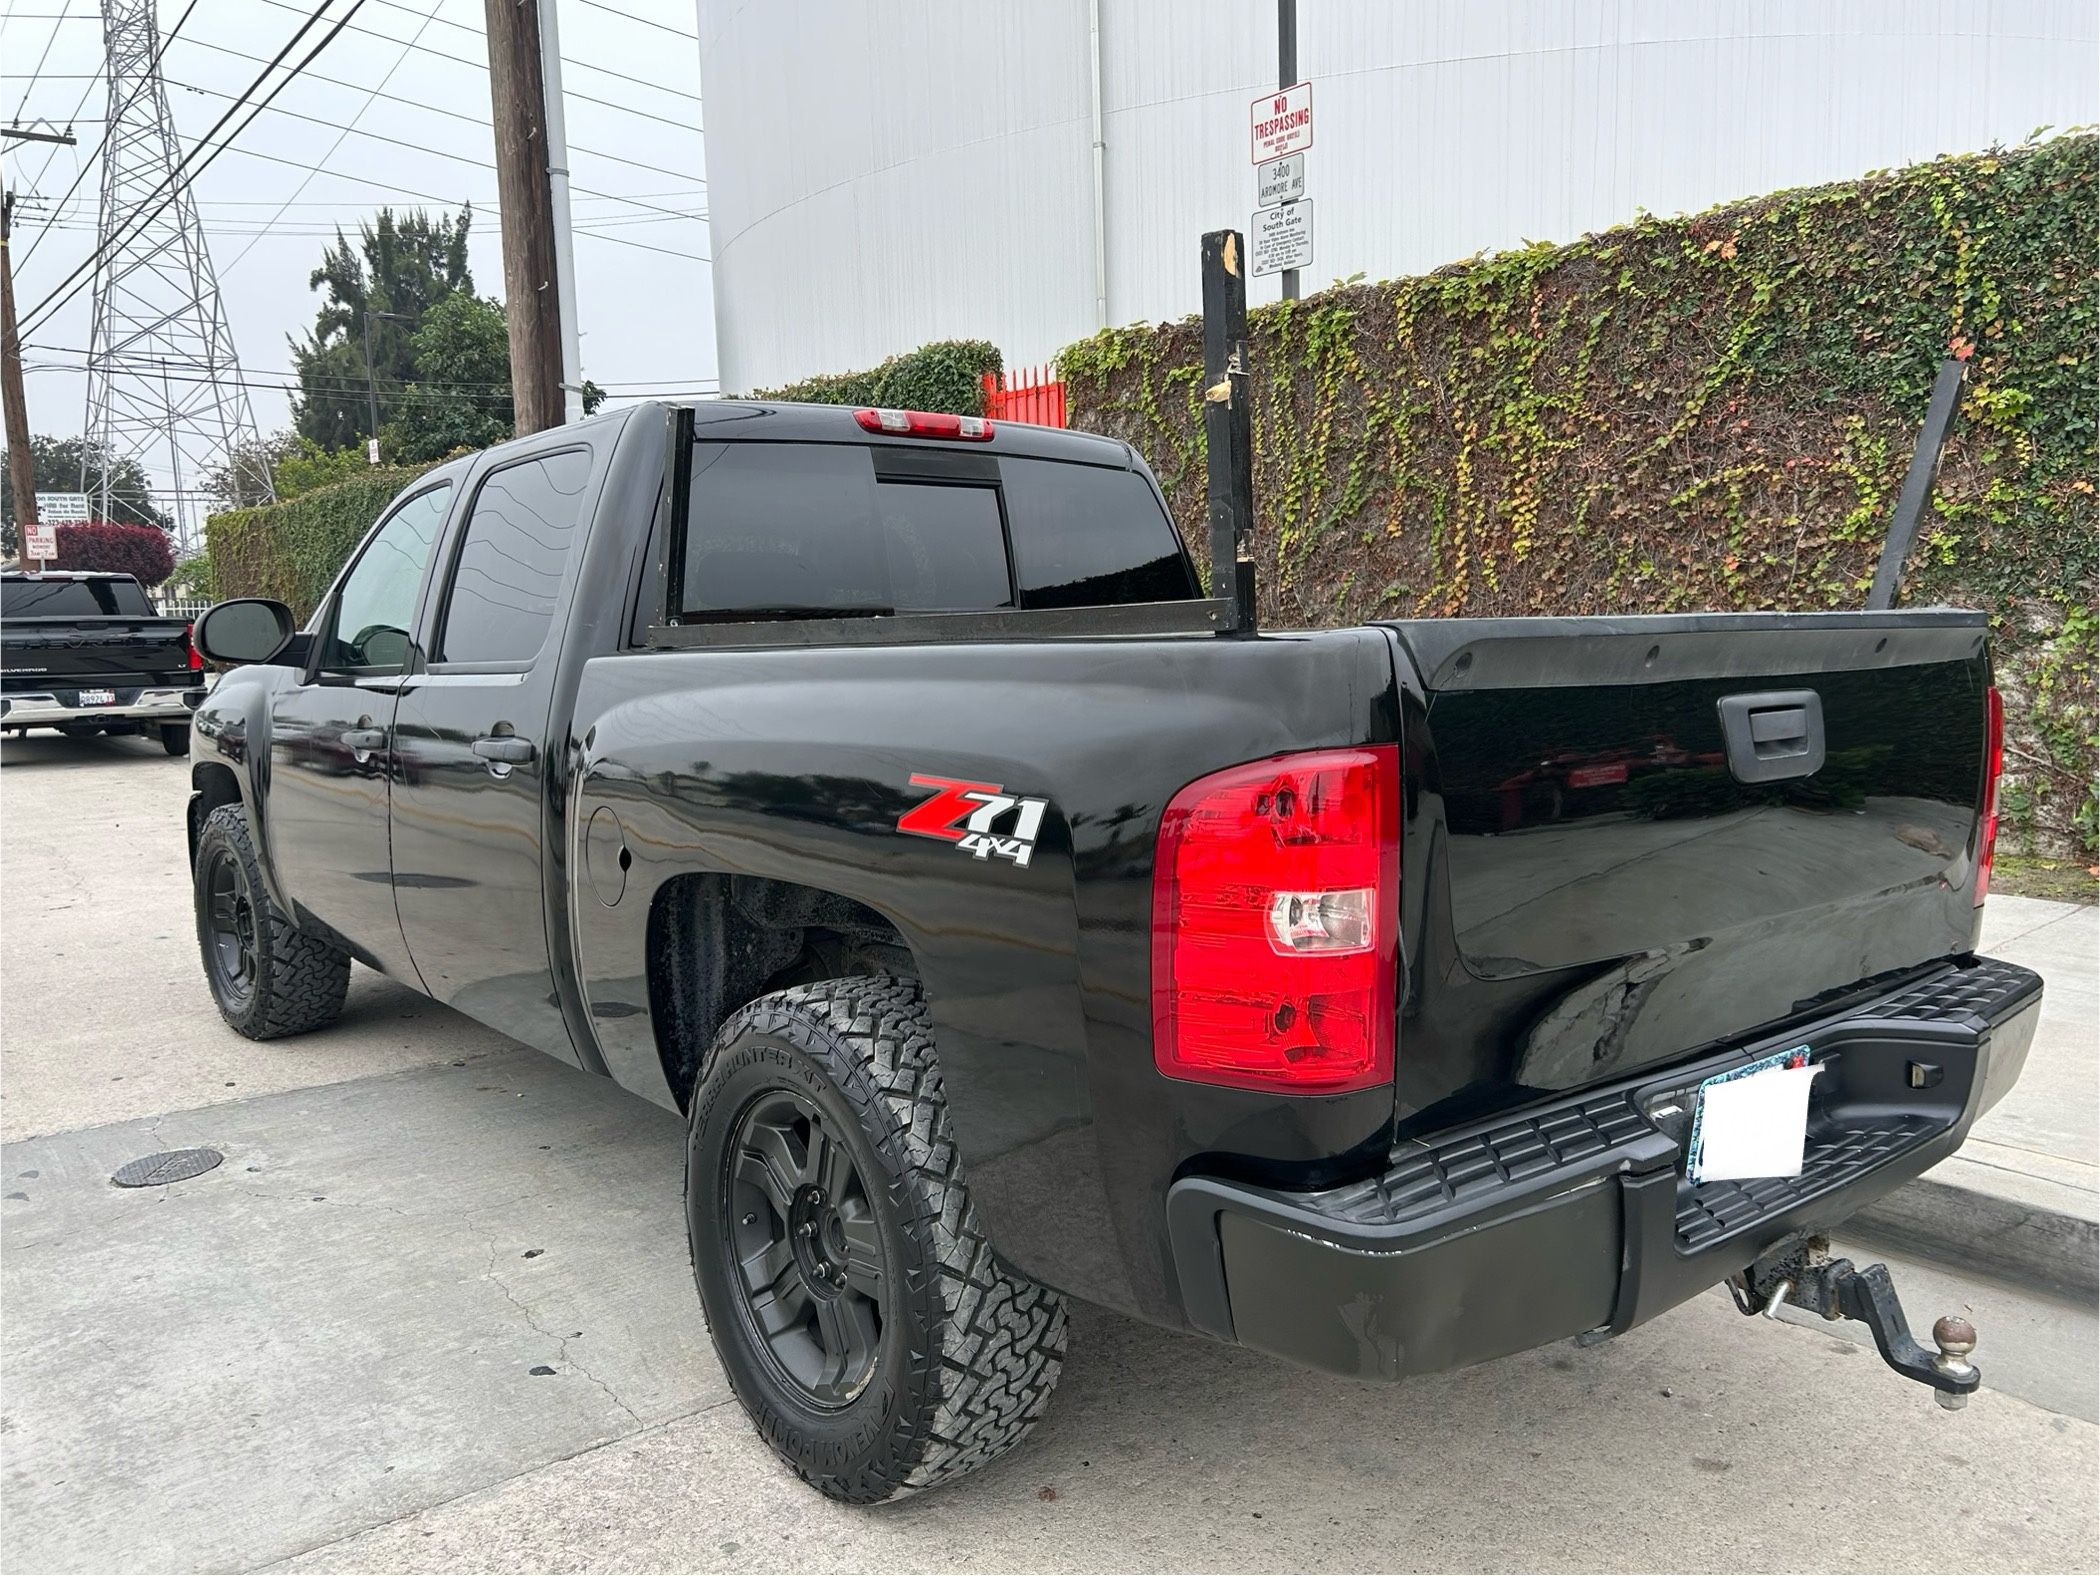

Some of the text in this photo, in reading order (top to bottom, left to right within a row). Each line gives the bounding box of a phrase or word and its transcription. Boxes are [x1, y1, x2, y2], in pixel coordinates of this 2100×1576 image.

[1274, 96, 1287, 116] NO
[1254, 108, 1309, 140] TRESPASSING
[1272, 164, 1290, 180] 3400
[1261, 176, 1302, 199] ARDMORE AVE
[1270, 207, 1294, 220] City of
[1263, 217, 1302, 232] South Gate
[28, 526, 36, 534] NO
[896, 772, 1049, 841] Z71
